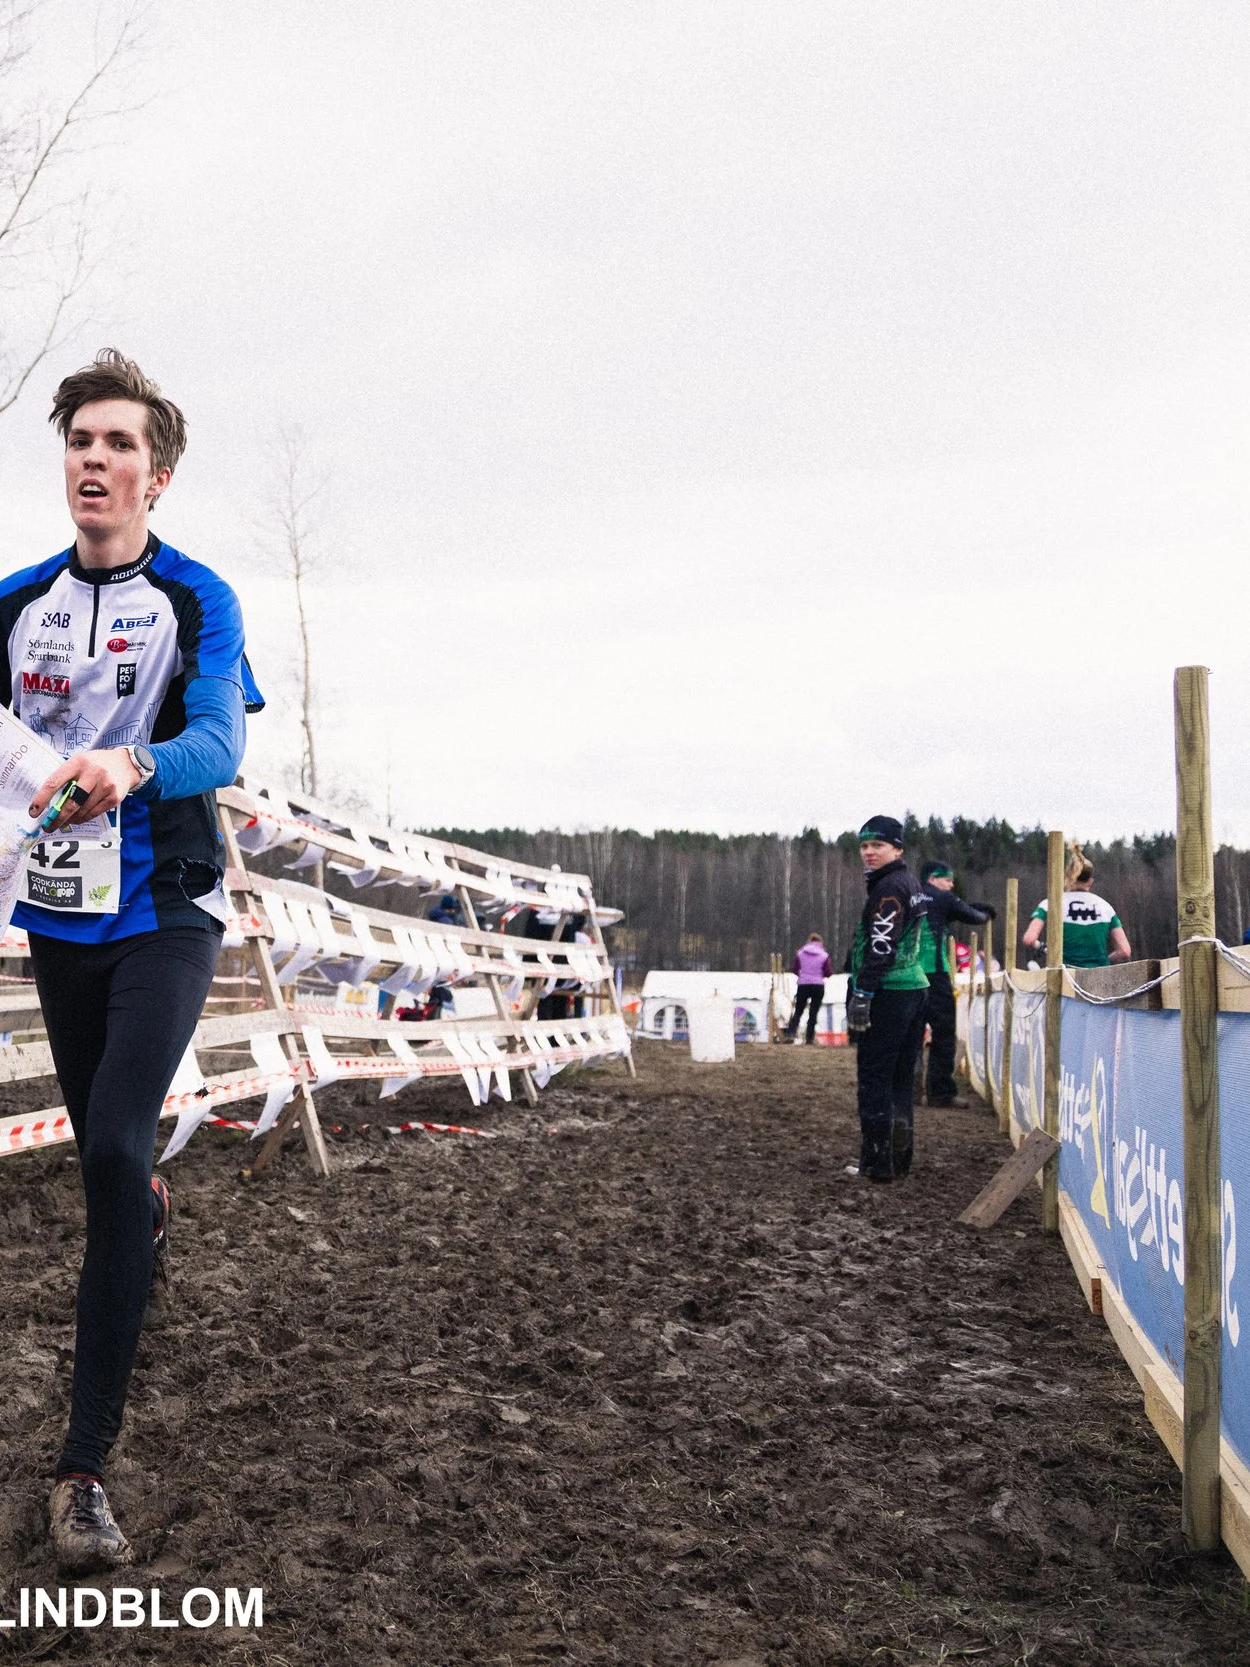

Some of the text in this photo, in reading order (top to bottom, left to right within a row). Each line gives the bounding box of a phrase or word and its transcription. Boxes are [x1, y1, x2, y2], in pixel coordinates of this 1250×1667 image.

[110, 551, 153, 581] noname
[23, 672, 70, 695] MAXI
[120, 675, 133, 683] FO
[30, 841, 80, 868] 42
[871, 911, 897, 955] OKK
